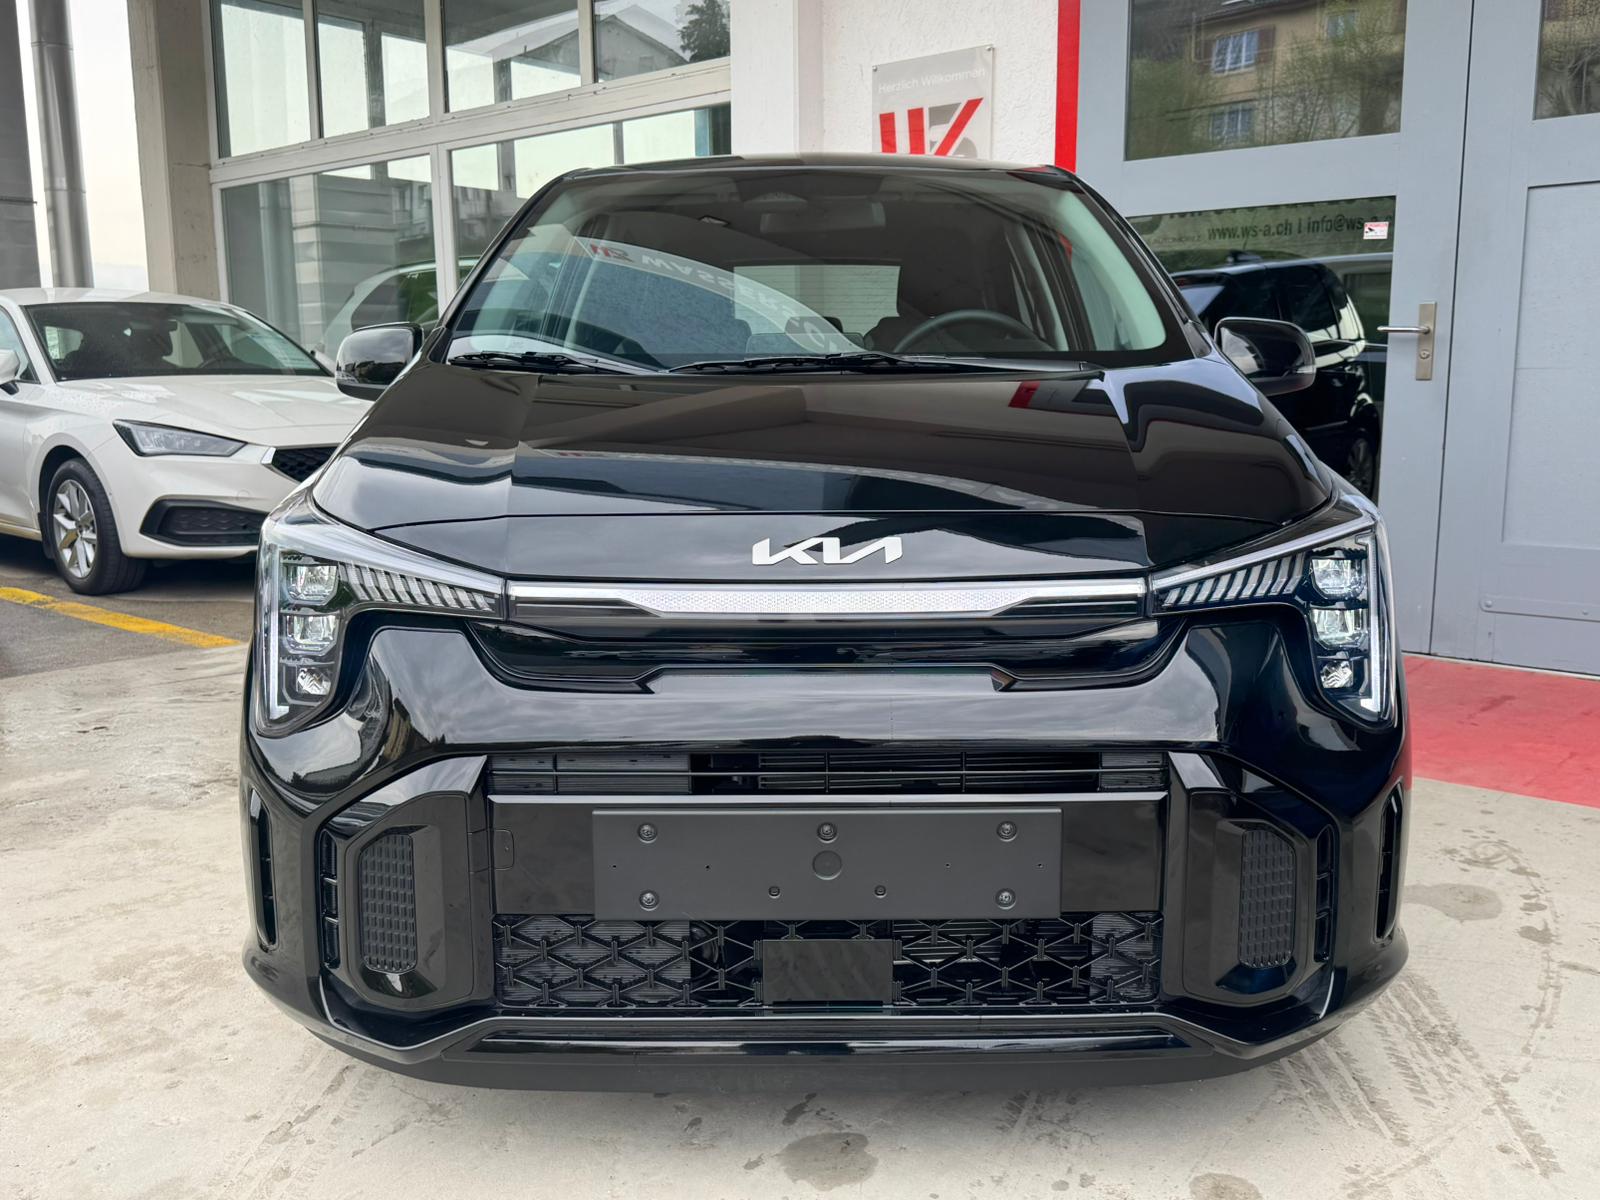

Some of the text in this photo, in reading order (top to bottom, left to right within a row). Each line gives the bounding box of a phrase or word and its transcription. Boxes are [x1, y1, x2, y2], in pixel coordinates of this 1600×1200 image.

[879, 67, 986, 94] Herzlich Willkommen
[1207, 218, 1292, 240] www.ws-a.ch
[1307, 214, 1394, 234] info@ws
[752, 536, 903, 565] KIA
